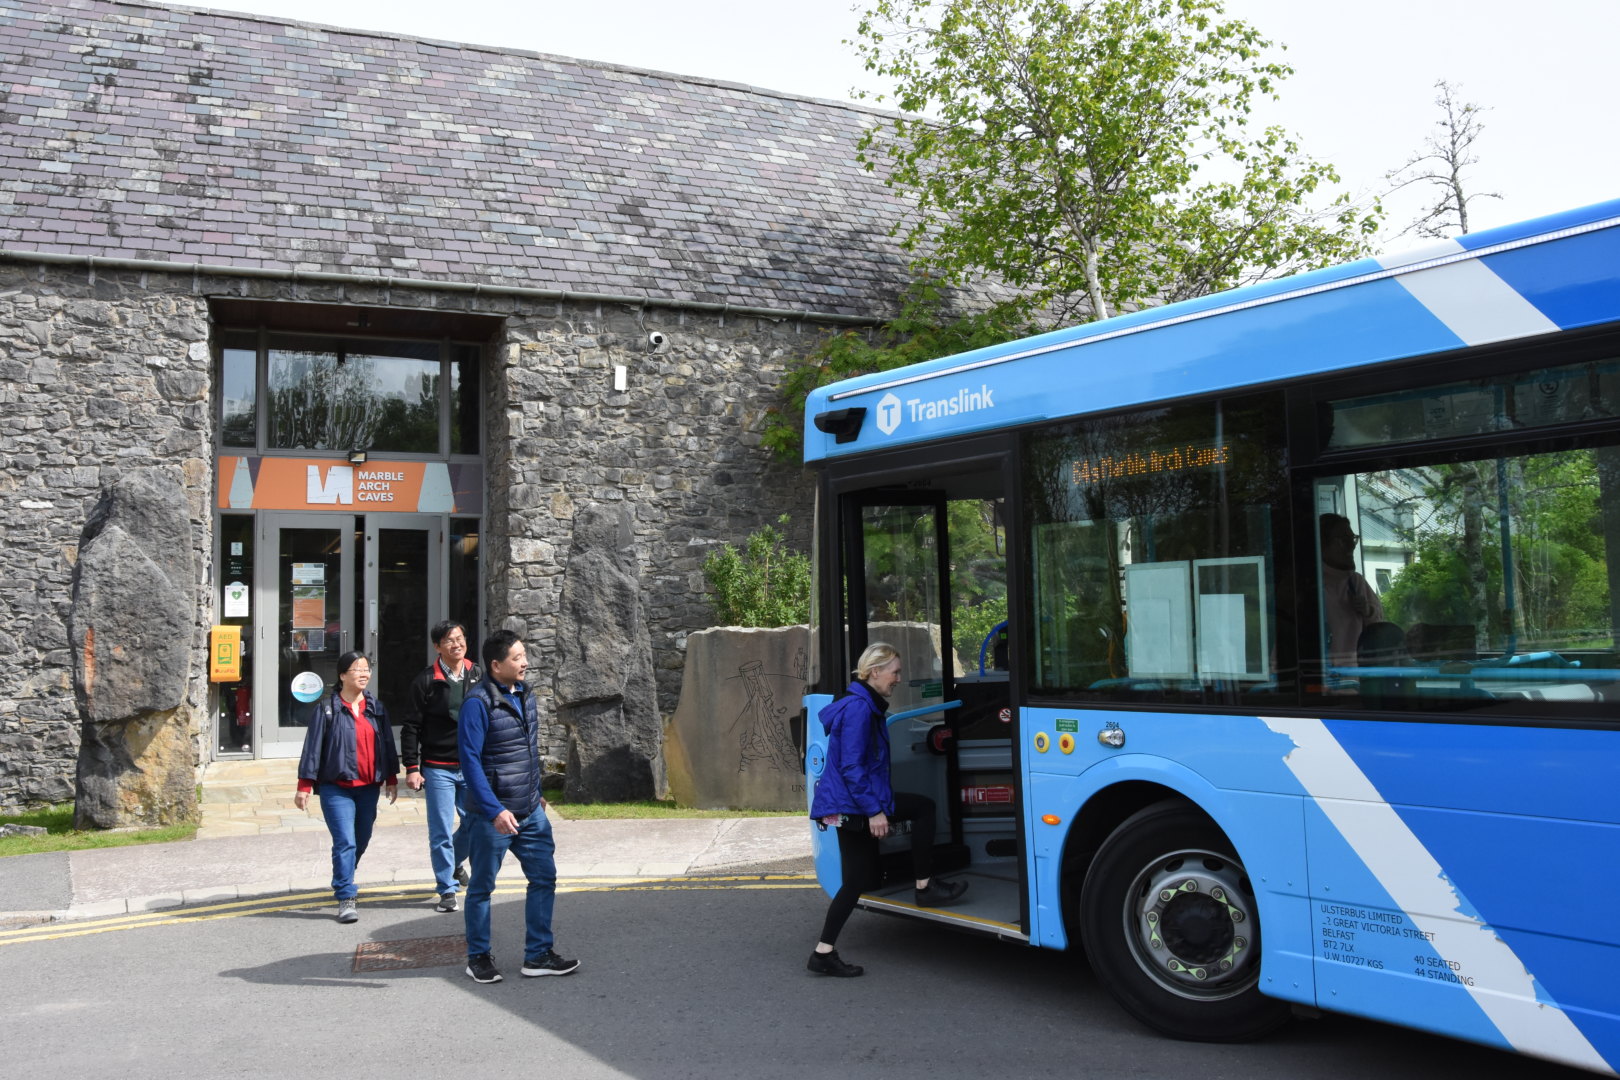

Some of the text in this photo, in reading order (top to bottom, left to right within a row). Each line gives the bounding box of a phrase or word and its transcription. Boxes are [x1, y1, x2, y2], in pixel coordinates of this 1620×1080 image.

[907, 384, 994, 422] Translink
[1101, 452, 1146, 478] Marble
[1150, 447, 1182, 472] Arch
[1186, 445, 1229, 467] Caves
[358, 471, 404, 481] MARBLE
[358, 482, 390, 491] ARCH
[357, 492, 394, 502] CAVES
[1321, 904, 1403, 925] ULSTERBUS LIMITED
[1322, 928, 1355, 941] BELFAST
[1333, 917, 1359, 930] GREAT
[1361, 922, 1401, 937] VICTORIA
[1403, 929, 1435, 942] STREET
[1323, 940, 1355, 953] BT2 7LX
[1367, 959, 1384, 969] KGS
[1414, 955, 1461, 971] 40 SEATED
[1414, 968, 1475, 987] 44 STANDING
